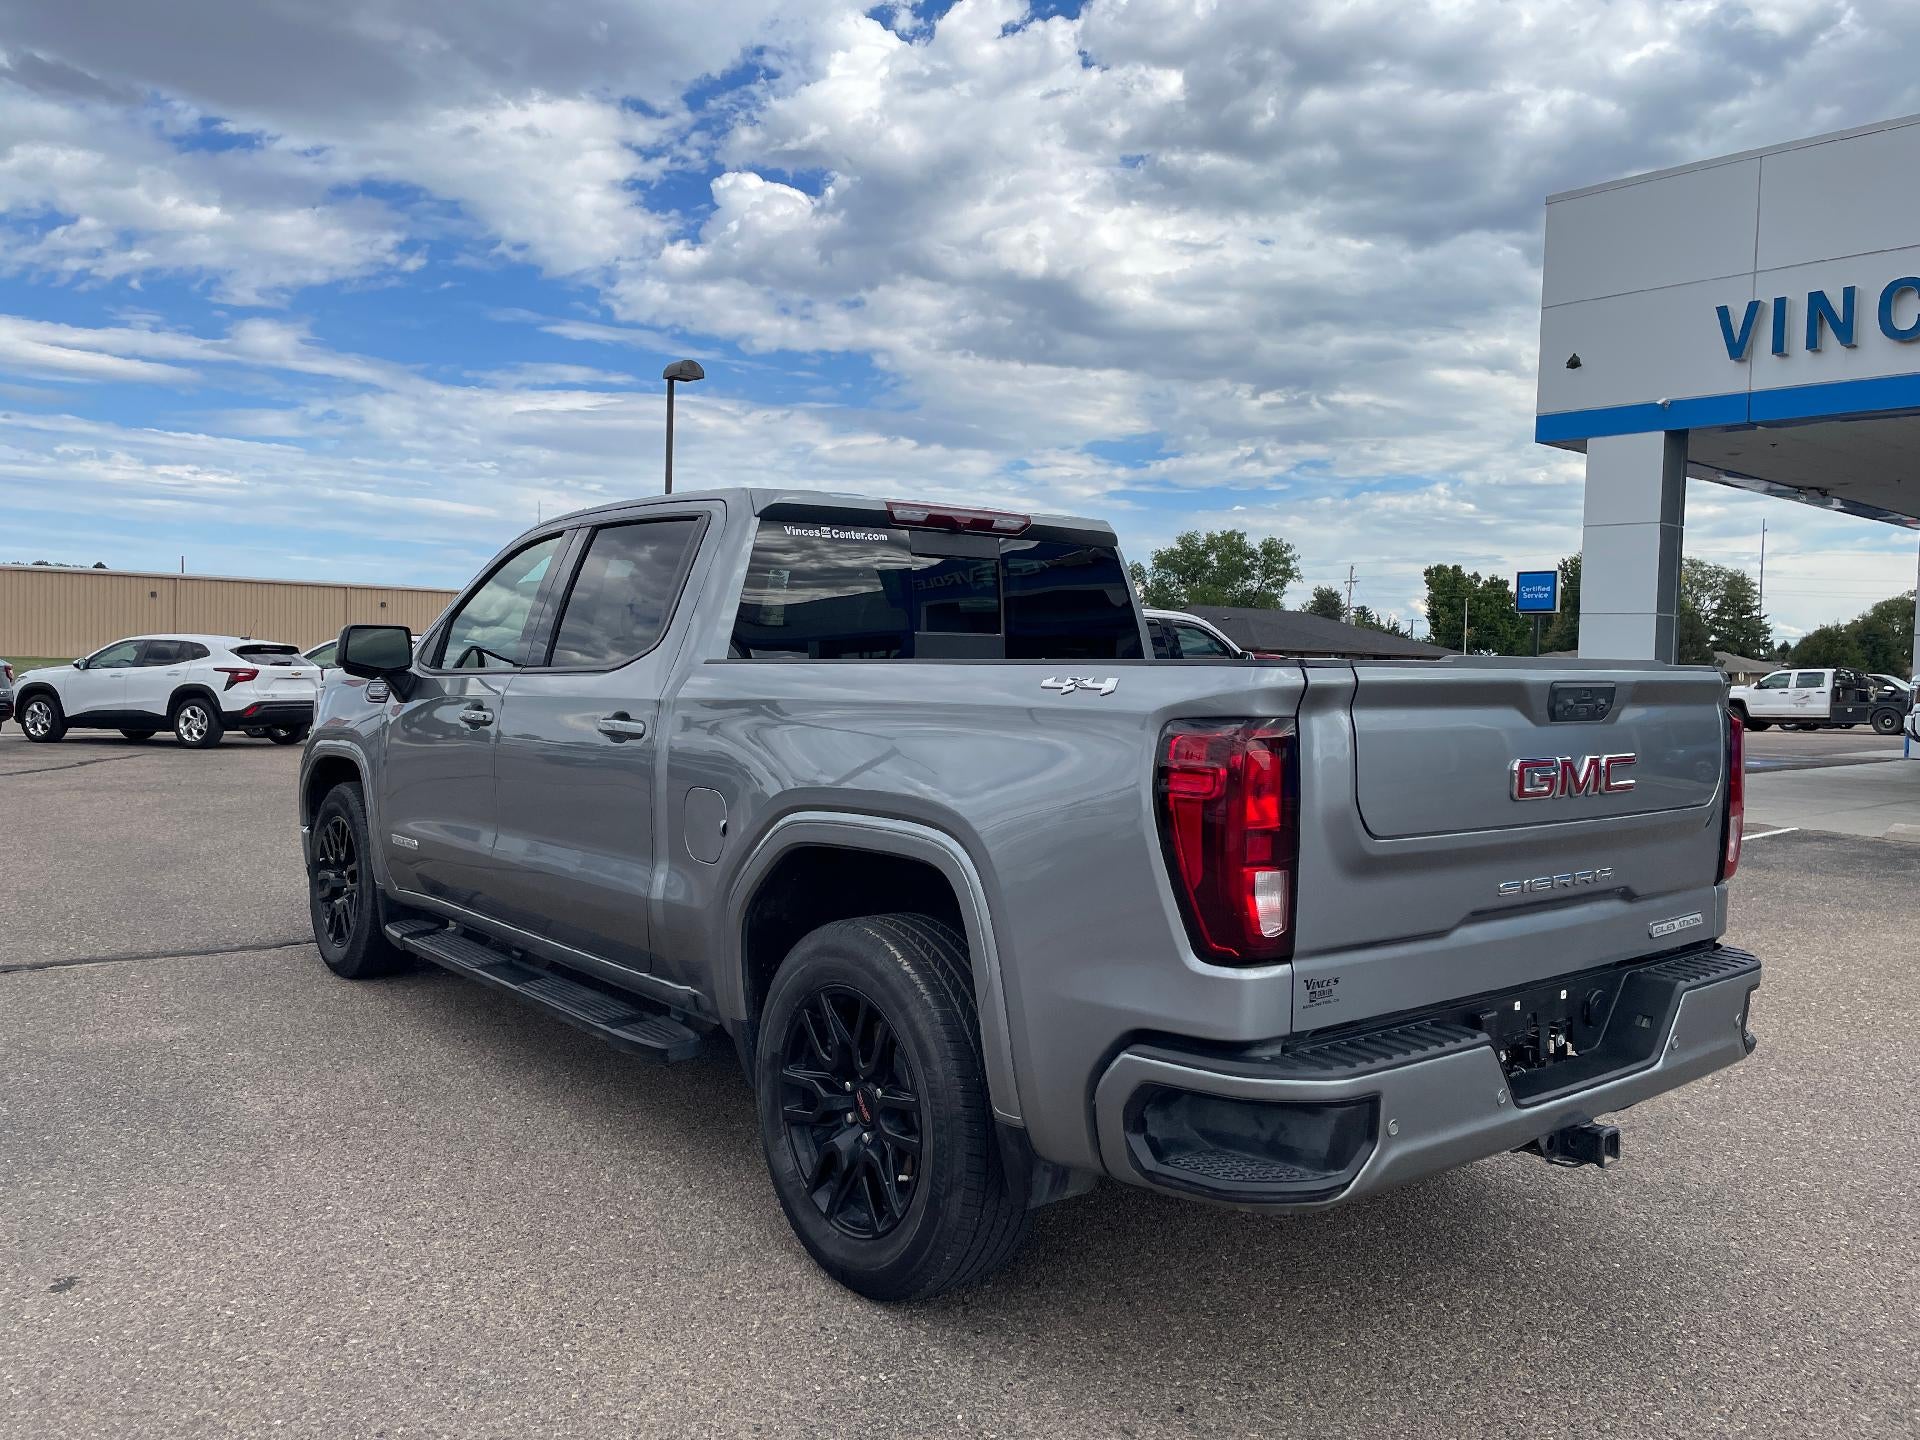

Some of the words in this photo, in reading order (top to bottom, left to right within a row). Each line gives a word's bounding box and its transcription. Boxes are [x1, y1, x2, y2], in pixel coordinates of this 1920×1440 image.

[1715, 276, 1920, 362] VINC
[1510, 752, 1637, 801] GMC
[1498, 866, 1614, 897] SIERRA
